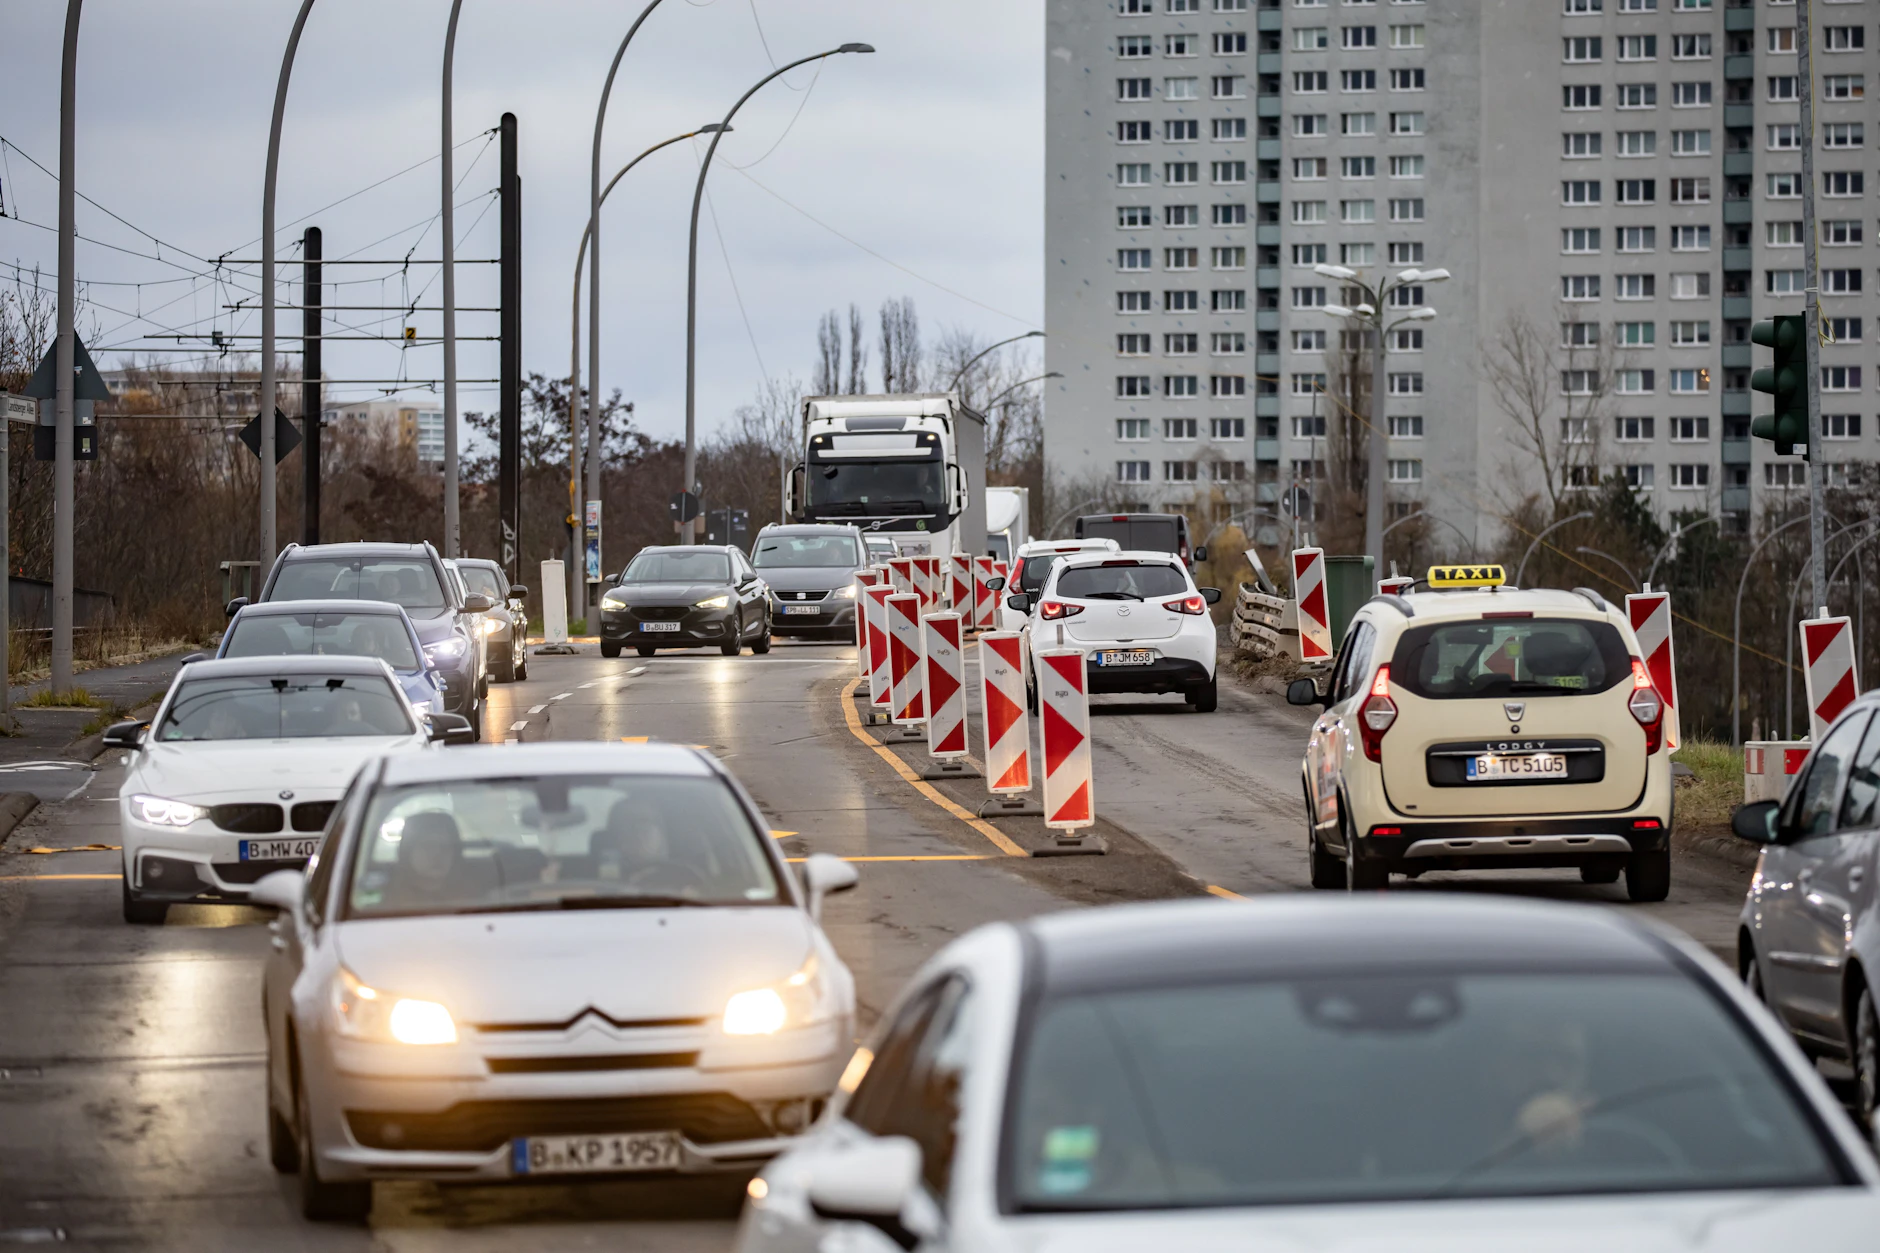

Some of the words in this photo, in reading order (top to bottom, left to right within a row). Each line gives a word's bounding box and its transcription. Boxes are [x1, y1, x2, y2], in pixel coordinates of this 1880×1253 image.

[407, 328, 415, 340] 2
[1441, 568, 1493, 580] TAXI
[664, 623, 677, 631] 317
[1106, 653, 1113, 663] B
[1119, 653, 1131, 663] JM
[1132, 652, 1151, 662] 658
[1486, 742, 1546, 751] LODGY
[1477, 760, 1488, 775] B
[1499, 758, 1520, 774] TC
[1522, 757, 1564, 773] 5105
[249, 843, 260, 858] B
[270, 842, 291, 857] MW
[295, 840, 320, 856] 40
[530, 1141, 549, 1168] B
[565, 1137, 602, 1165] KP
[610, 1132, 679, 1165] 1957
